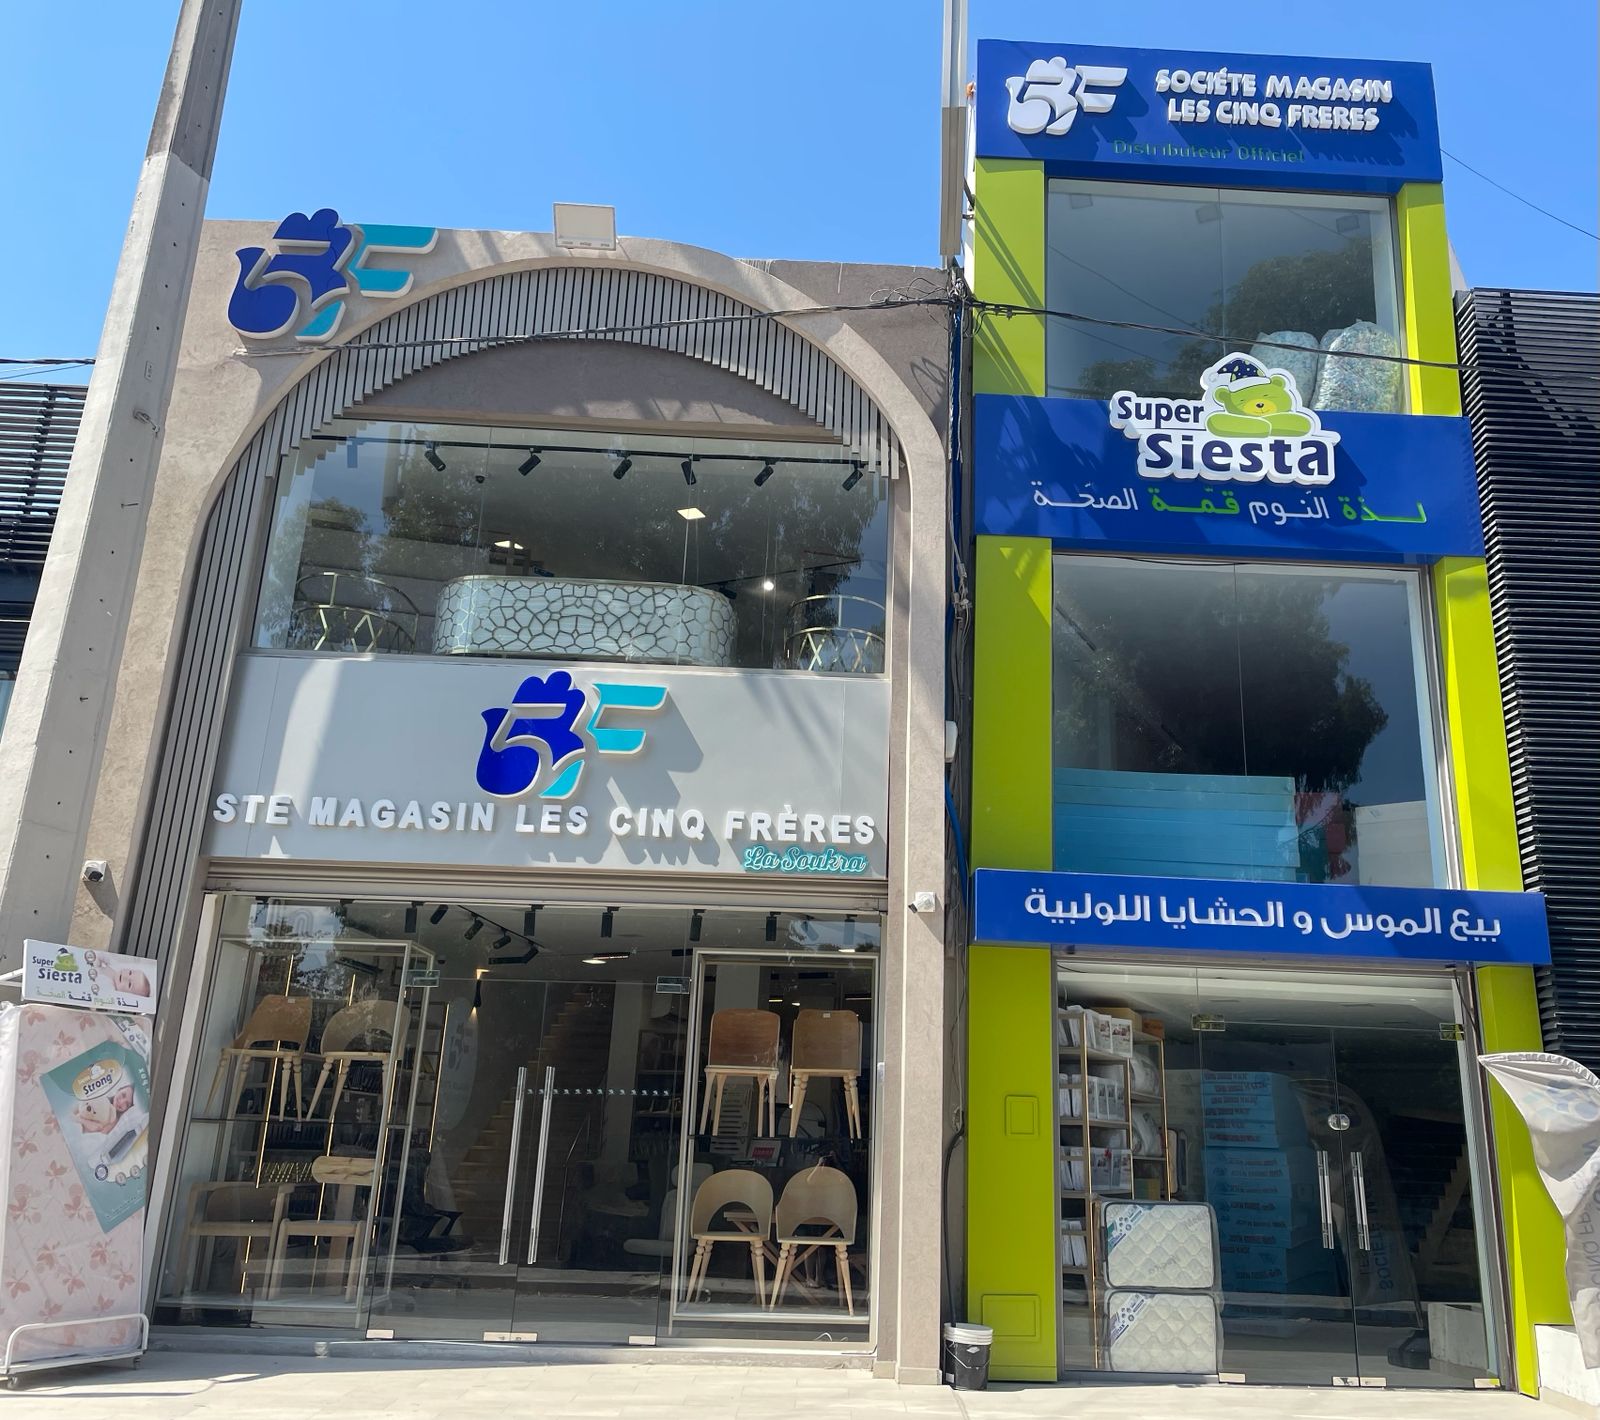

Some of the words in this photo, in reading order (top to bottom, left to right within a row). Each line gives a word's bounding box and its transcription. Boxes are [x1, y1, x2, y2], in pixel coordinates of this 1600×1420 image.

[1155, 66, 1257, 97] SOCIÉTE
[1265, 75, 1393, 103] MAGASIN
[1168, 98, 1211, 123] LES
[1215, 101, 1282, 128] CINQ
[1287, 104, 1380, 131] FRERES
[1113, 139, 1228, 159] Distributeur
[1237, 146, 1305, 164] Officiel
[1117, 396, 1205, 429] Super
[1145, 433, 1329, 476] Siesta
[212, 793, 293, 825] STE
[308, 796, 496, 832] MAGASIN
[514, 804, 590, 835] LES
[608, 806, 705, 842] CINQ
[724, 803, 876, 845] FRÈRES
[743, 844, 780, 871] La
[780, 845, 867, 873] Soukra
[1024, 887, 1151, 926] اللولبية
[1160, 896, 1285, 930] الحشايا
[1293, 910, 1313, 935] و
[1320, 907, 1442, 939] الموس
[1449, 908, 1502, 943] بيع
[32, 956, 54, 967] Super
[38, 968, 83, 984] Siesta
[82, 1073, 114, 1096] Strong
